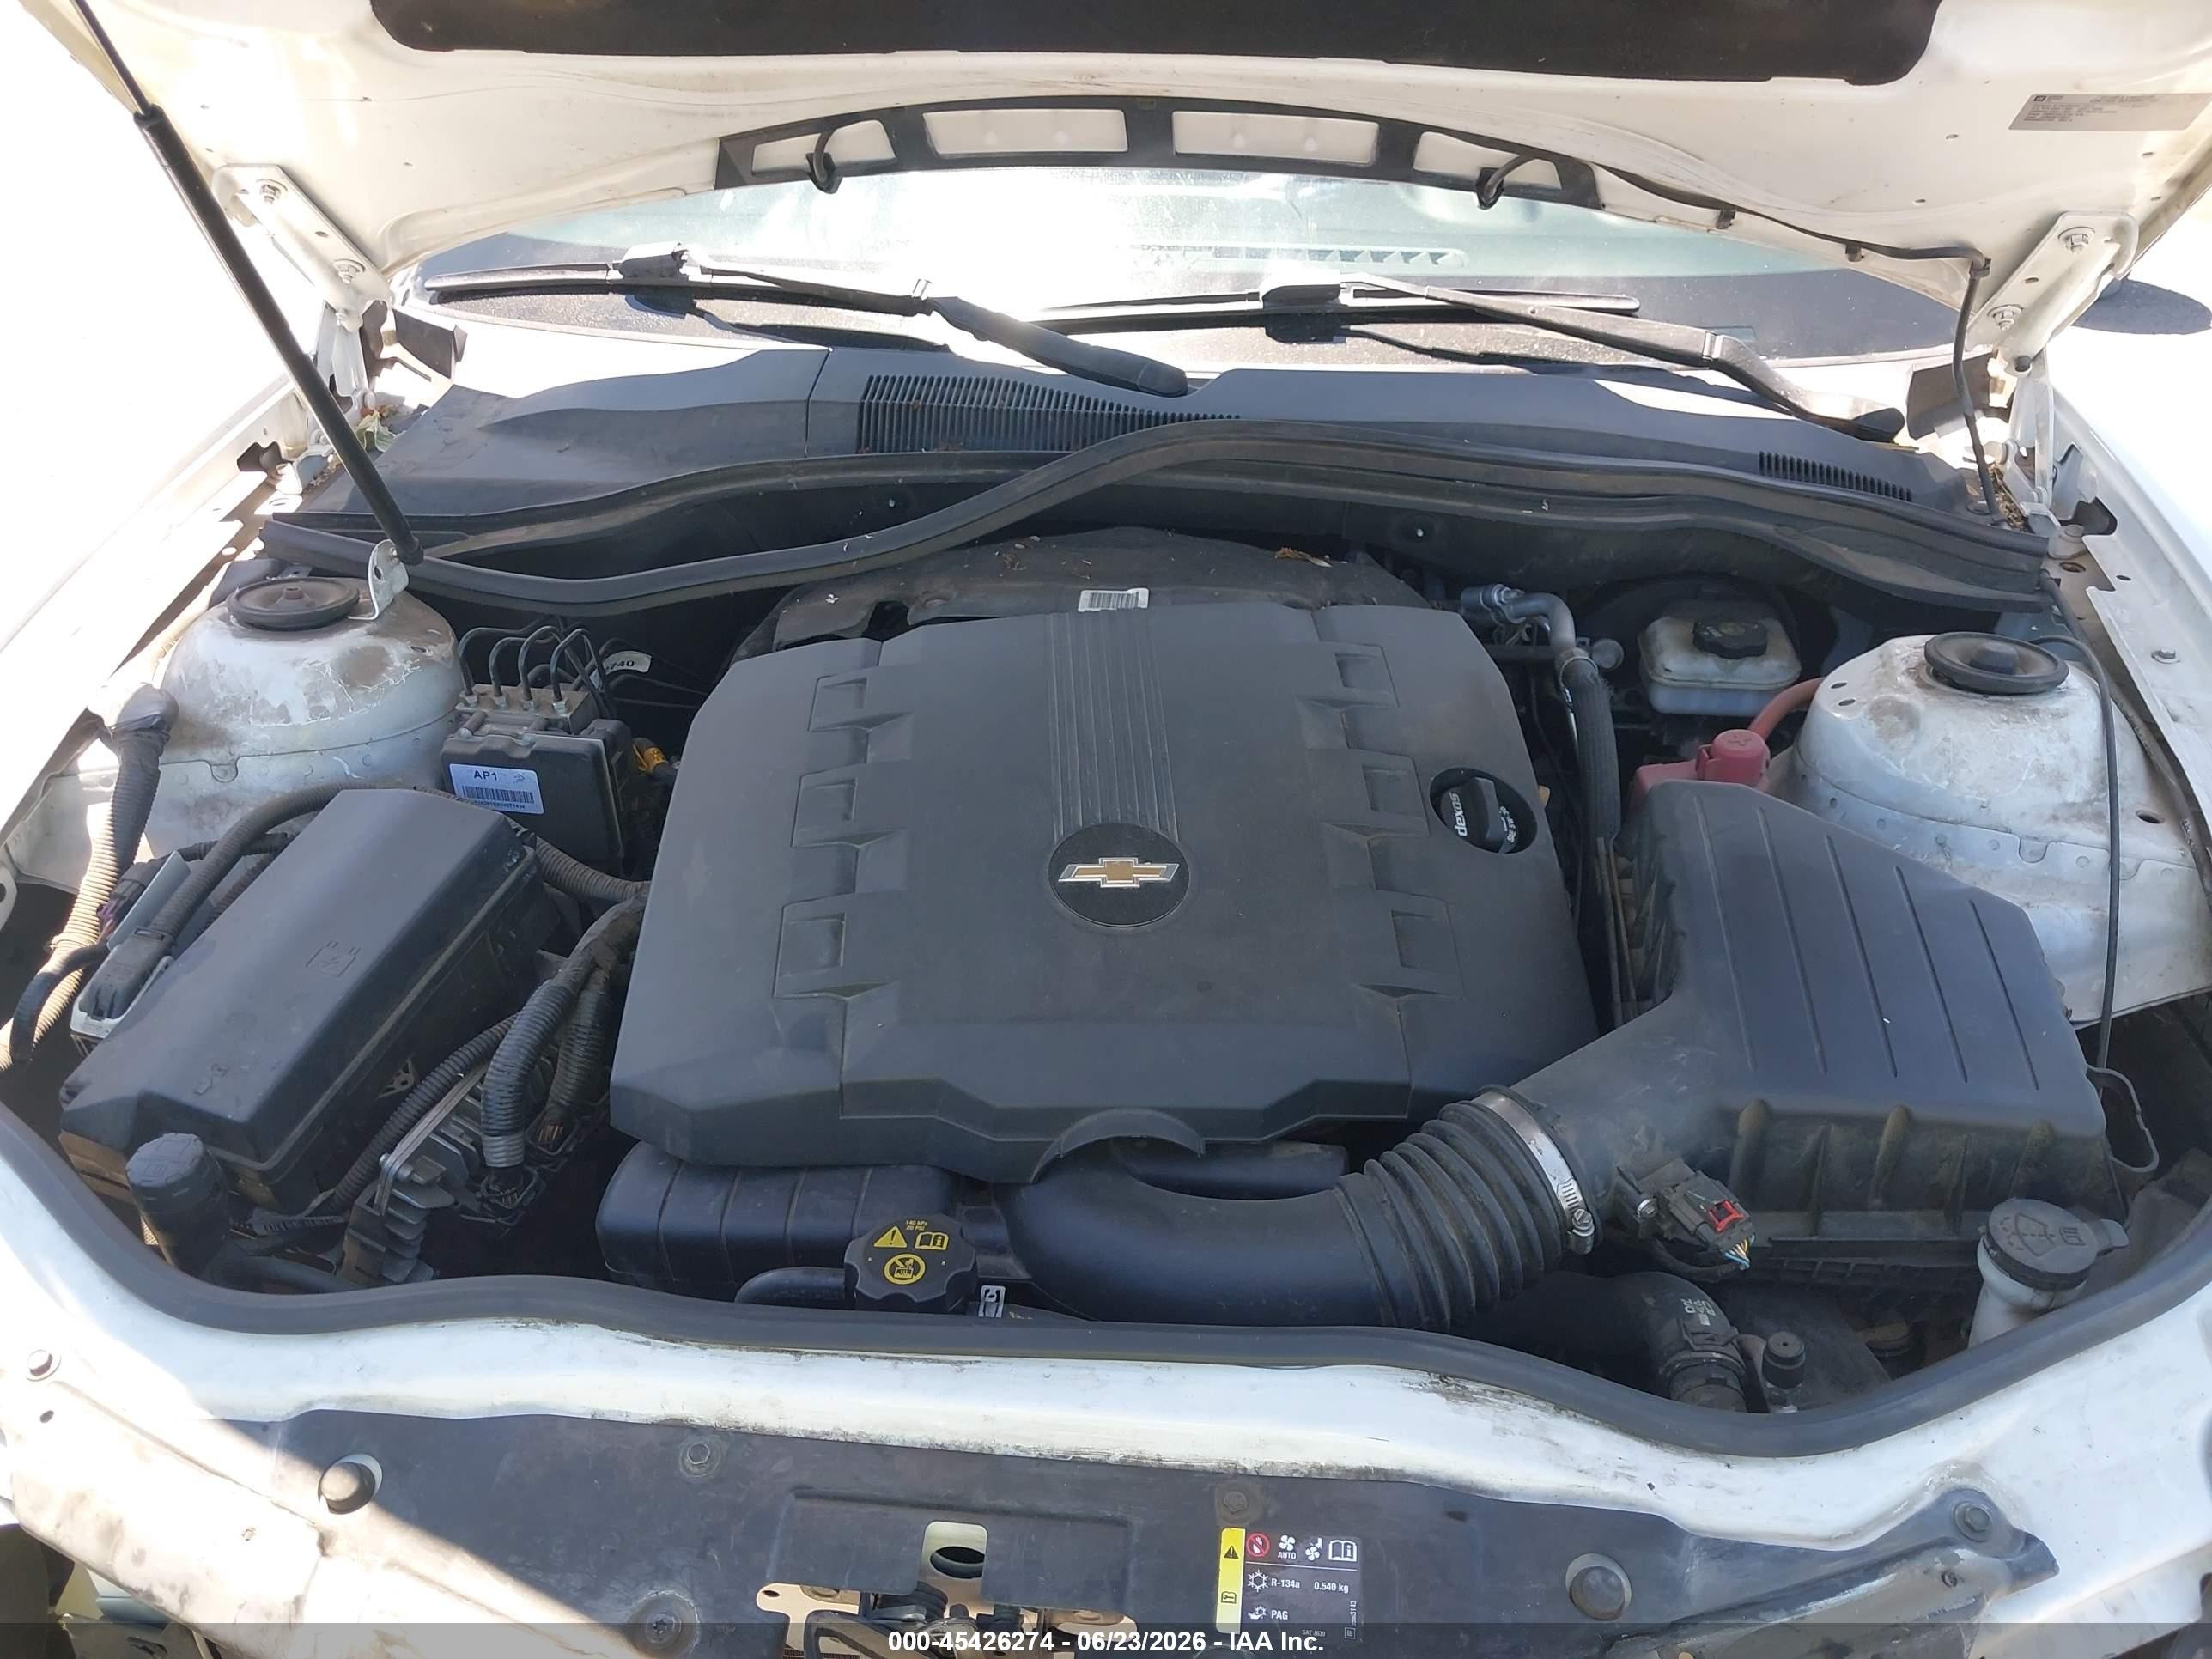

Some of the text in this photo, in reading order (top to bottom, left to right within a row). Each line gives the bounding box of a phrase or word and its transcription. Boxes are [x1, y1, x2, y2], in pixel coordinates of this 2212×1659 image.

[474, 769, 498, 781] AP1
[1449, 791, 1468, 836] dexos
[1278, 1551, 1297, 1559] AUTO
[1271, 1578, 1349, 1594] R-134a 0.540 kg
[1271, 1610, 1288, 1620] PAG
